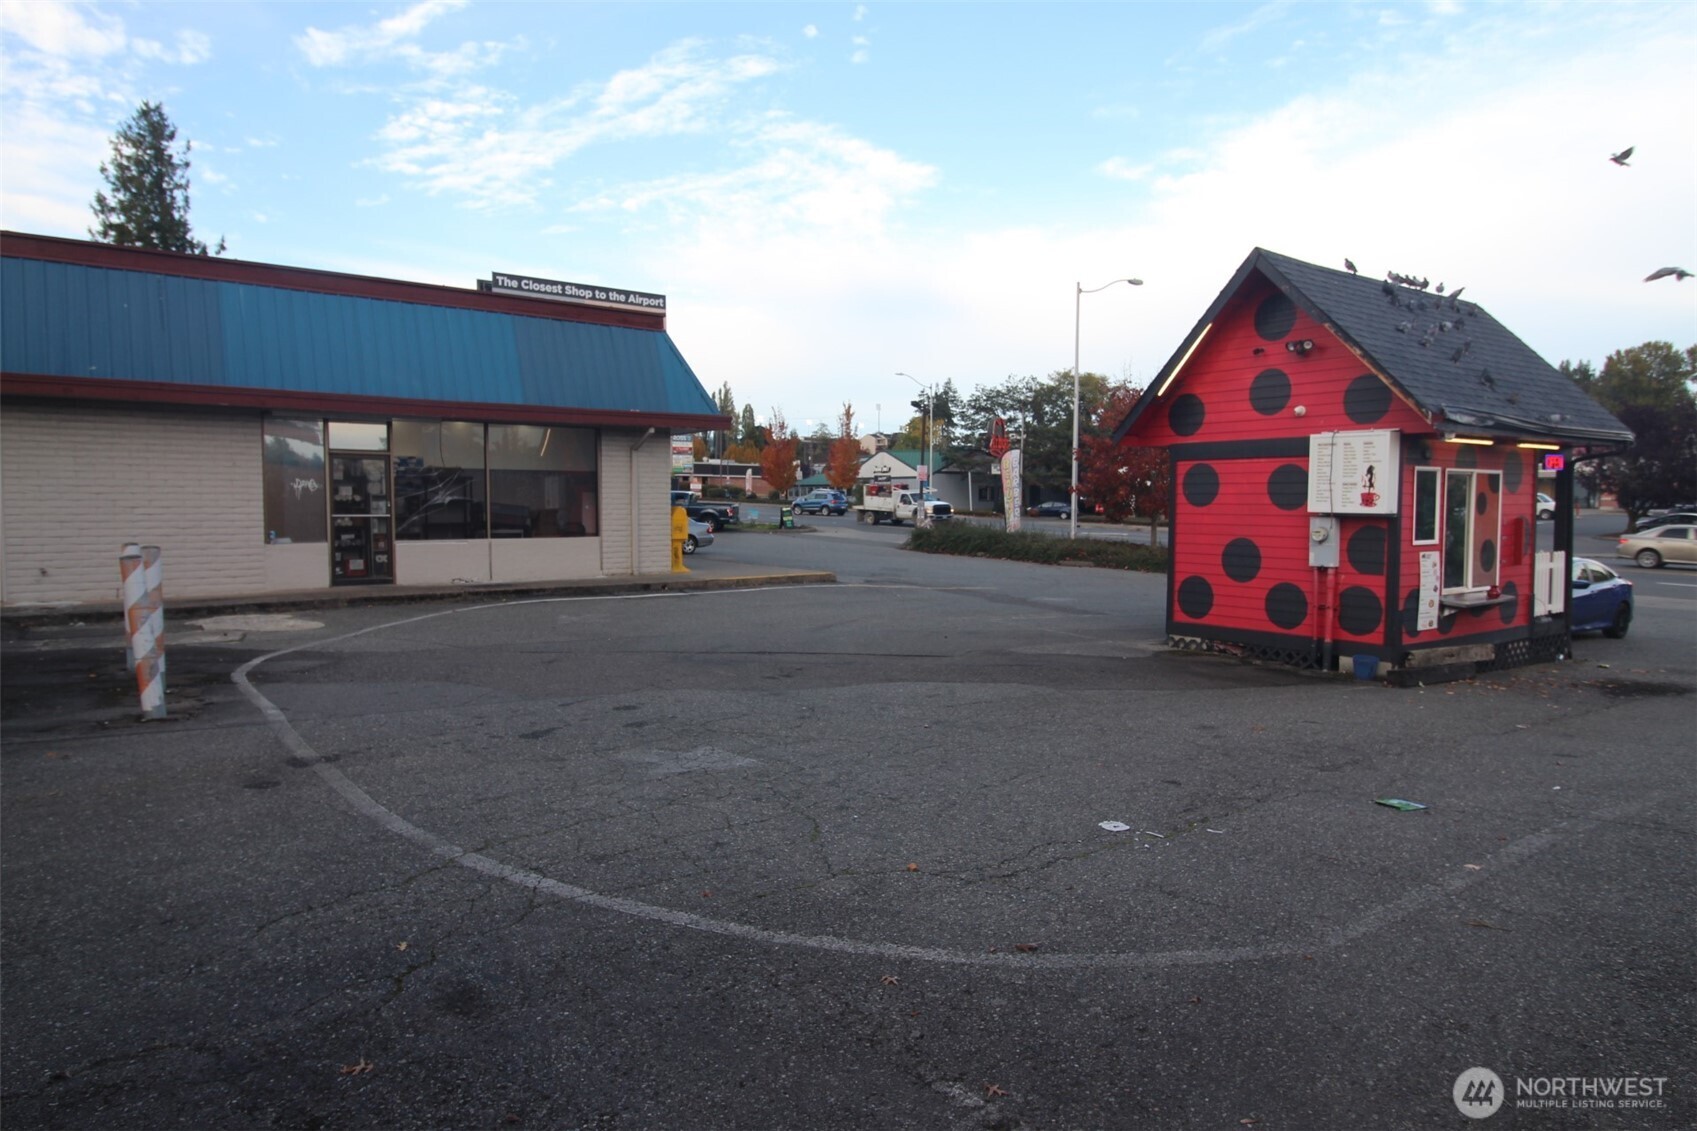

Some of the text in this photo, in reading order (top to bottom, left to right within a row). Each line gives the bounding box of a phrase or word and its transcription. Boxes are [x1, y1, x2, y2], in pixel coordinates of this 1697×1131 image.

[496, 276, 664, 307] The Closest Shop to the Airport
